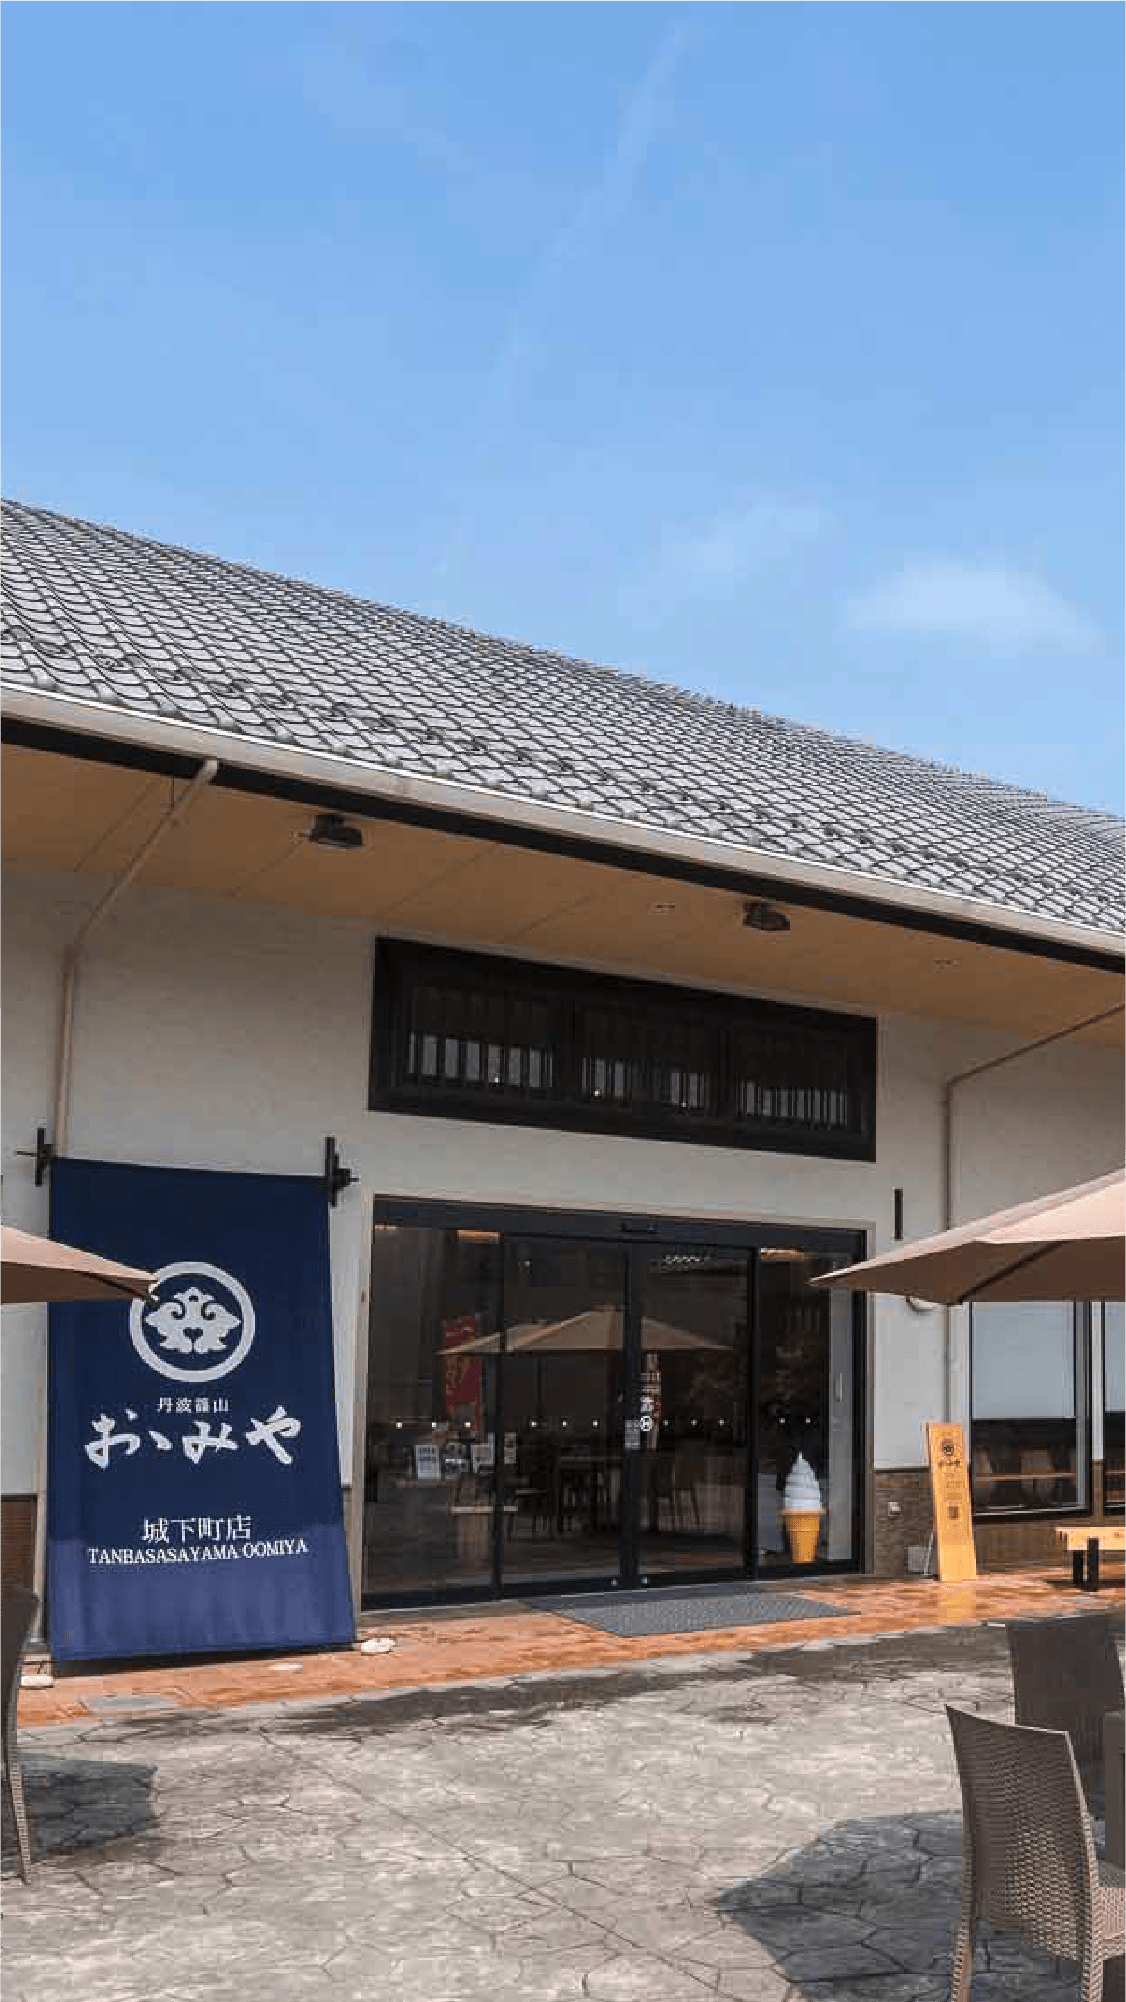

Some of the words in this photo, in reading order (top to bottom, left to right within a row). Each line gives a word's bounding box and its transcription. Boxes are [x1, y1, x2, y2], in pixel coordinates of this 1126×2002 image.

[141, 1514, 252, 1543] 城下町店
[88, 1544, 239, 1565] TANBASASAYAMA
[242, 1537, 309, 1559] OOMIYA
